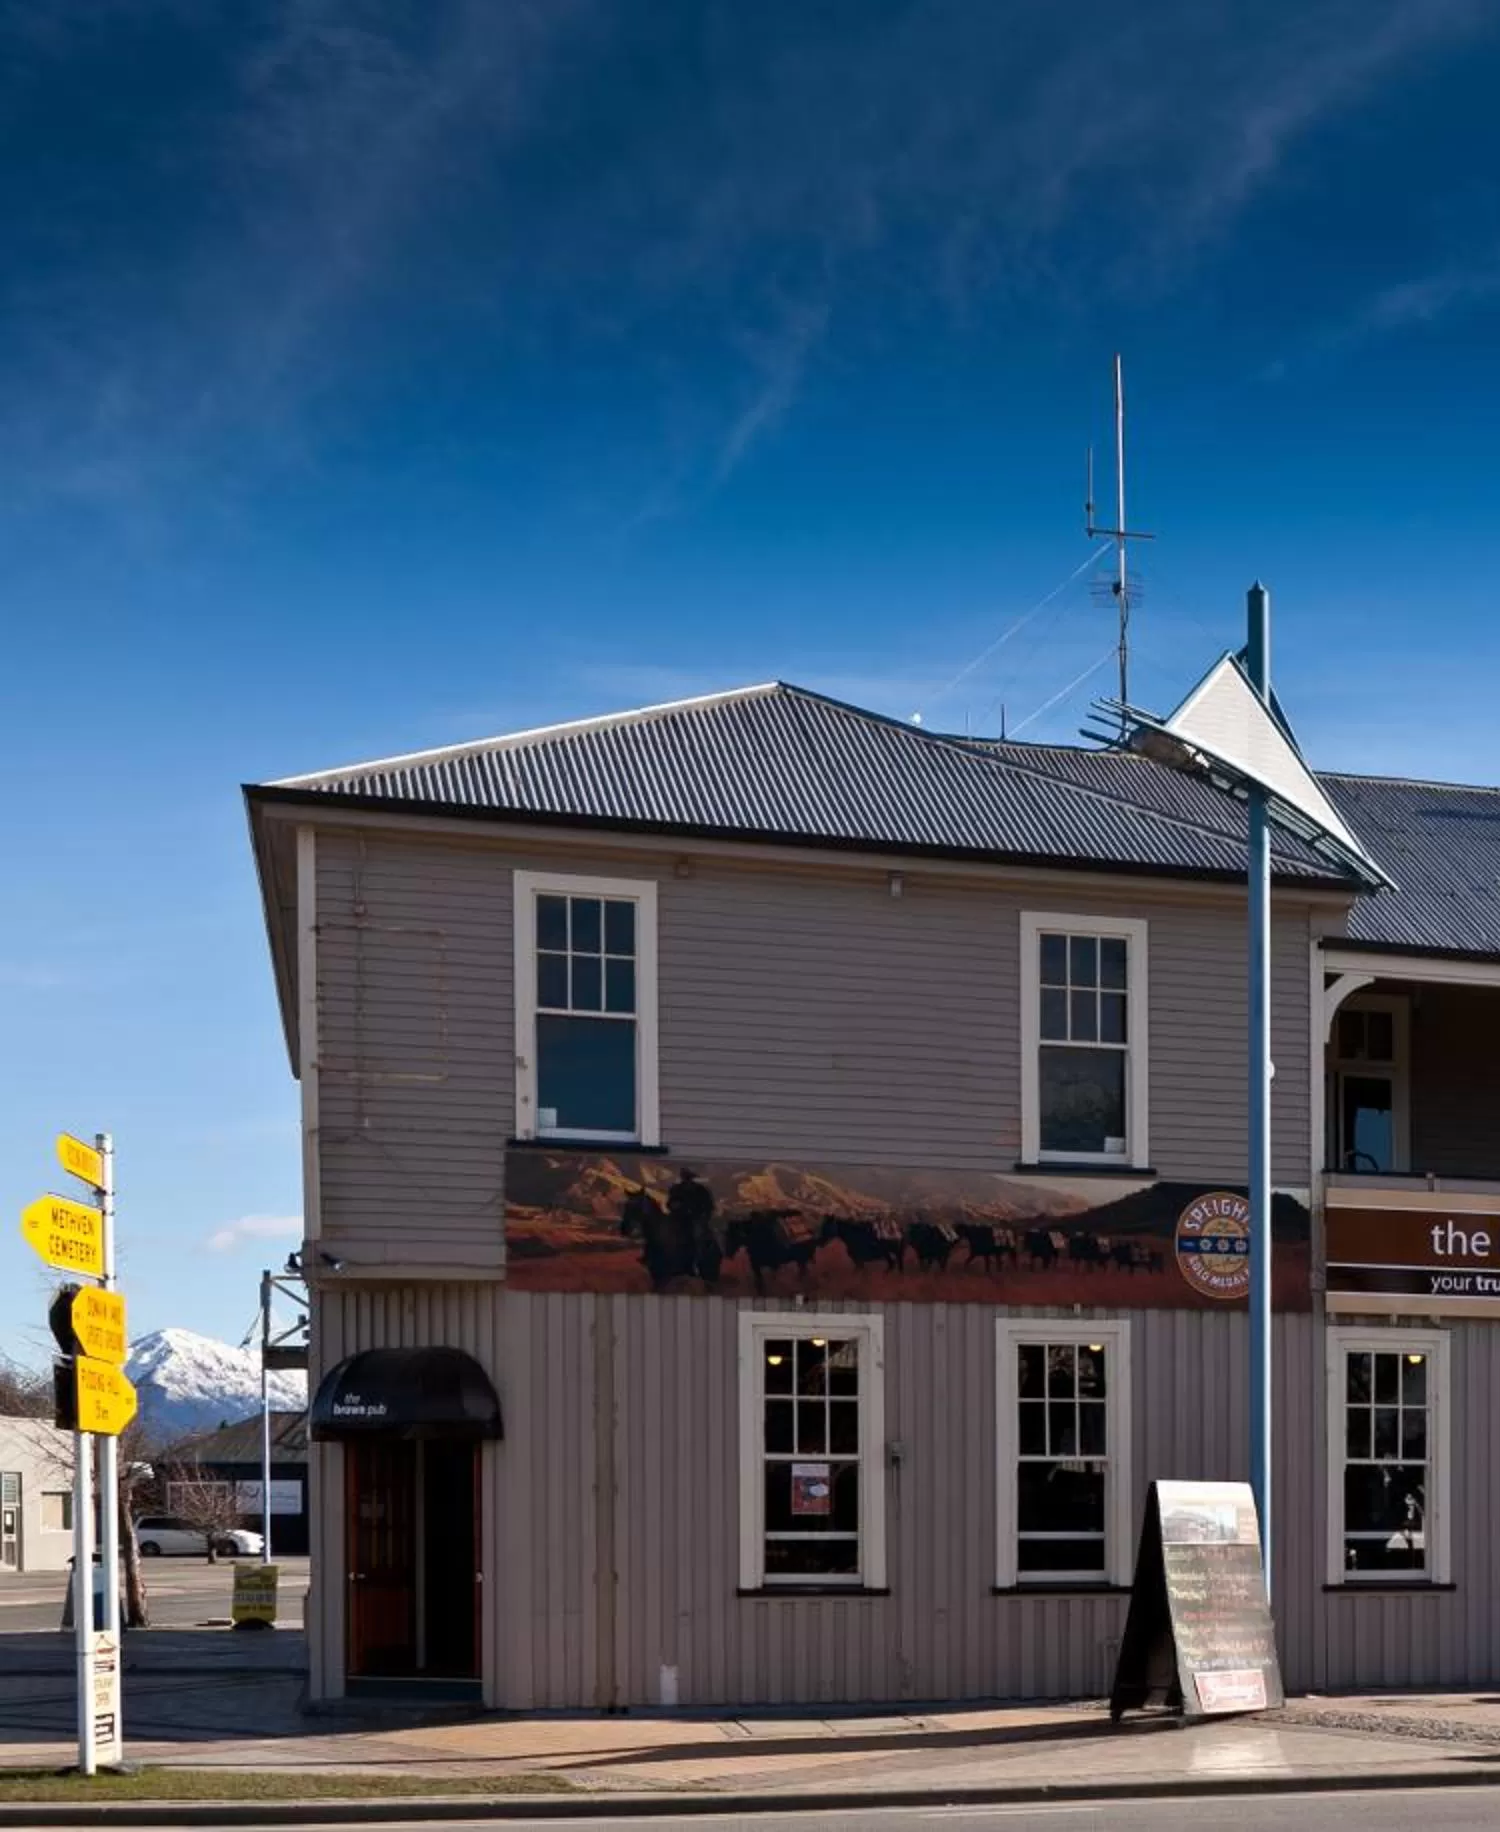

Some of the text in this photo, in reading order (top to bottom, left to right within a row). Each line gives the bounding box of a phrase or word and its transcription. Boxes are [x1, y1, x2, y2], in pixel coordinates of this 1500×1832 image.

[51, 1207, 95, 1236] METHVEN
[48, 1232, 97, 1264] CEMETERY
[1430, 1220, 1491, 1257] the
[1430, 1275, 1472, 1295] your
[333, 1402, 388, 1417] brown pub
